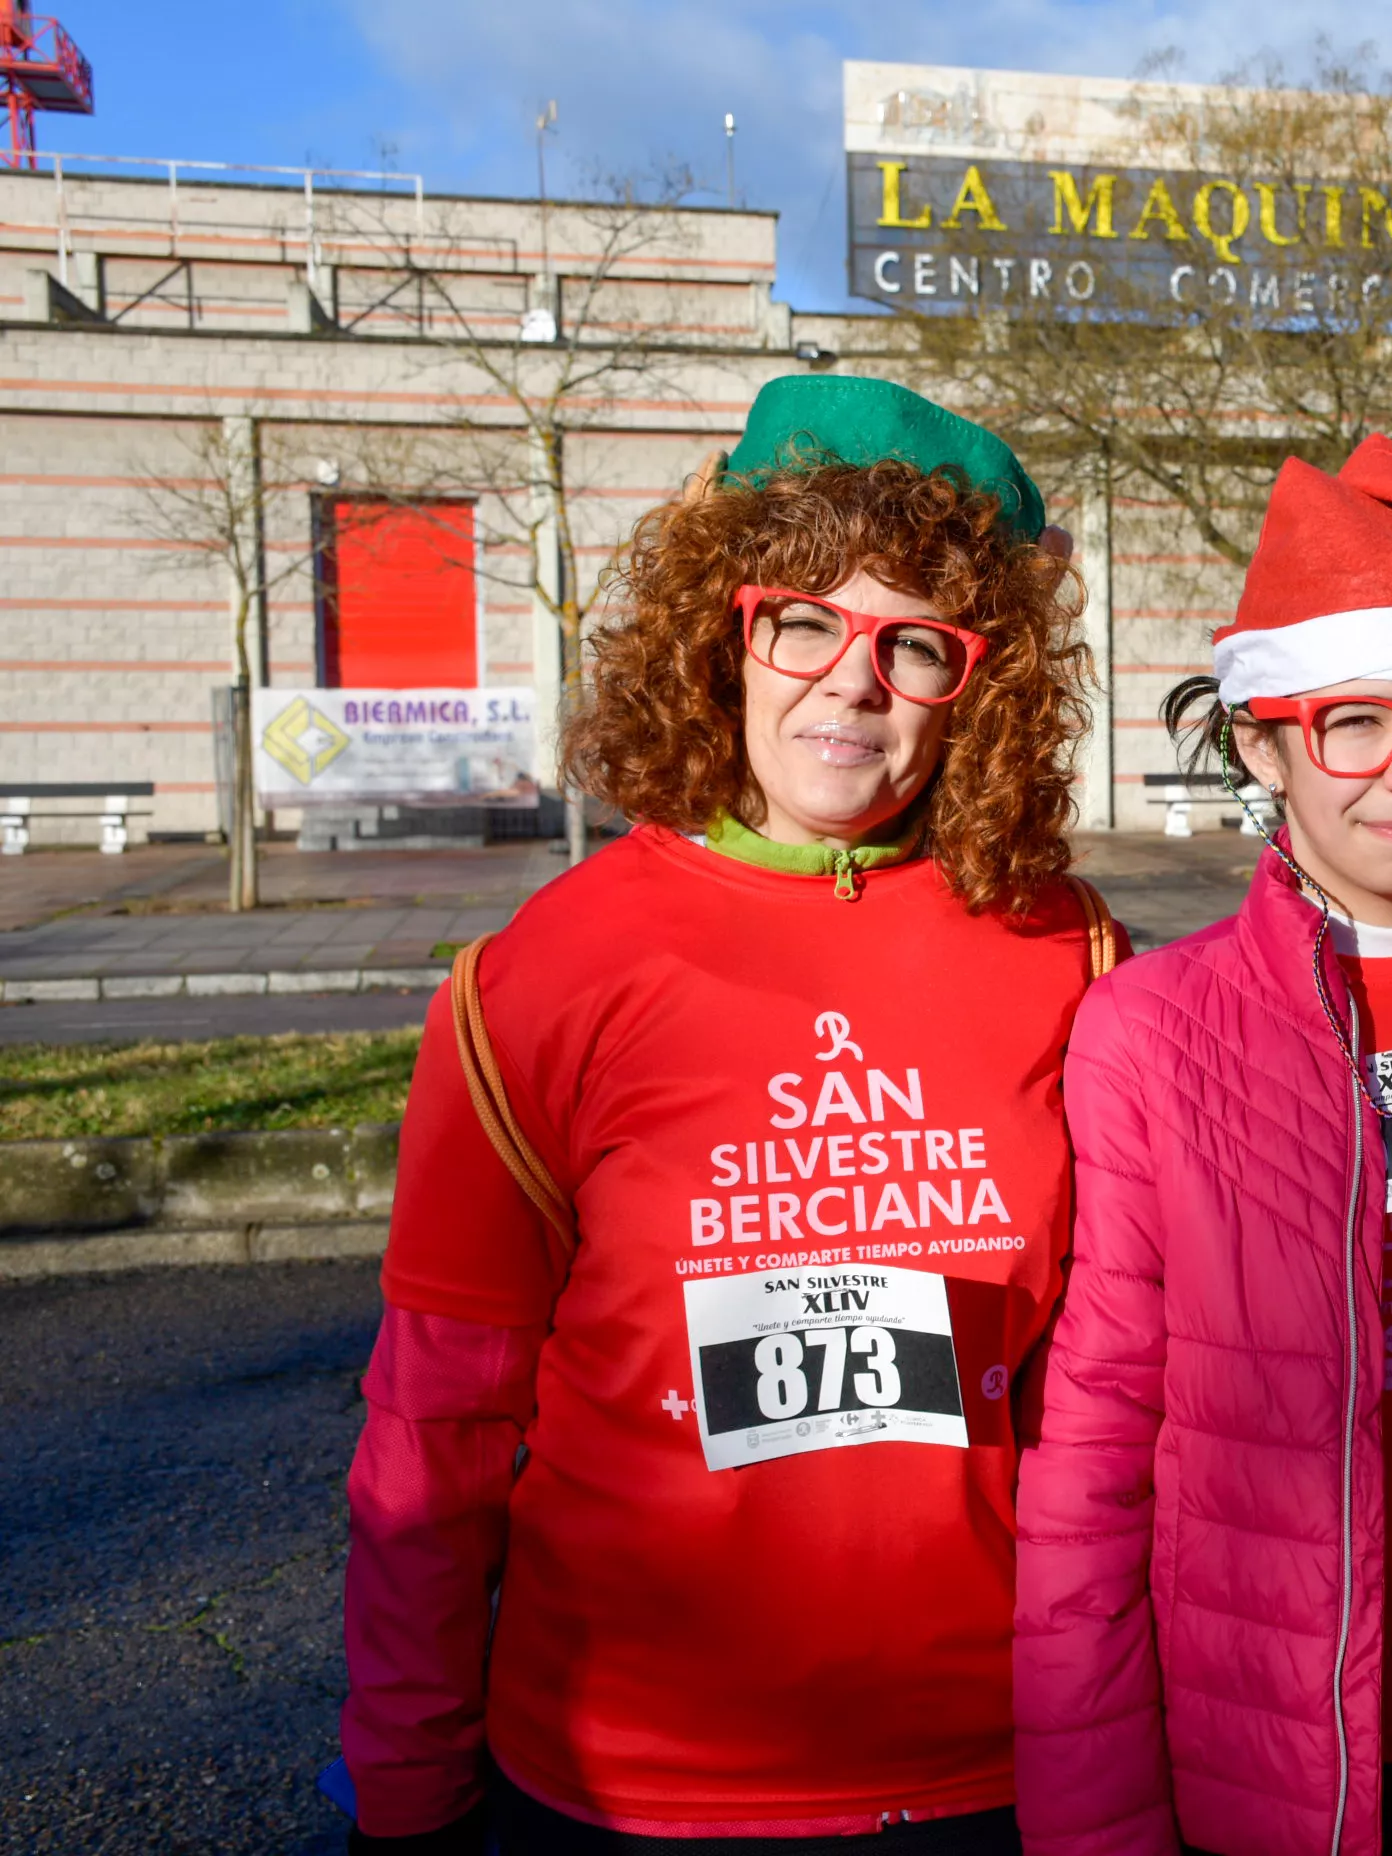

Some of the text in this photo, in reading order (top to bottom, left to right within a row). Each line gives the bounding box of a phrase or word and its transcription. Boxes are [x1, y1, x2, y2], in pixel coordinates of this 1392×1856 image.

[875, 161, 1008, 231] LA
[874, 251, 1095, 300] CENTRO
[767, 1068, 925, 1130] SAN
[711, 1128, 986, 1187] SILVESTRE
[690, 1178, 1011, 1247] BERCIANA
[675, 1236, 1026, 1275] ÚNETE Y COMPARTE TIEMPO AYUDANDO
[764, 1274, 889, 1294] SAN SILVESTRE
[803, 1289, 870, 1314] XLIV
[783, 1321, 790, 1331] y
[834, 1314, 864, 1323] tiempo
[754, 1326, 902, 1420] 873
